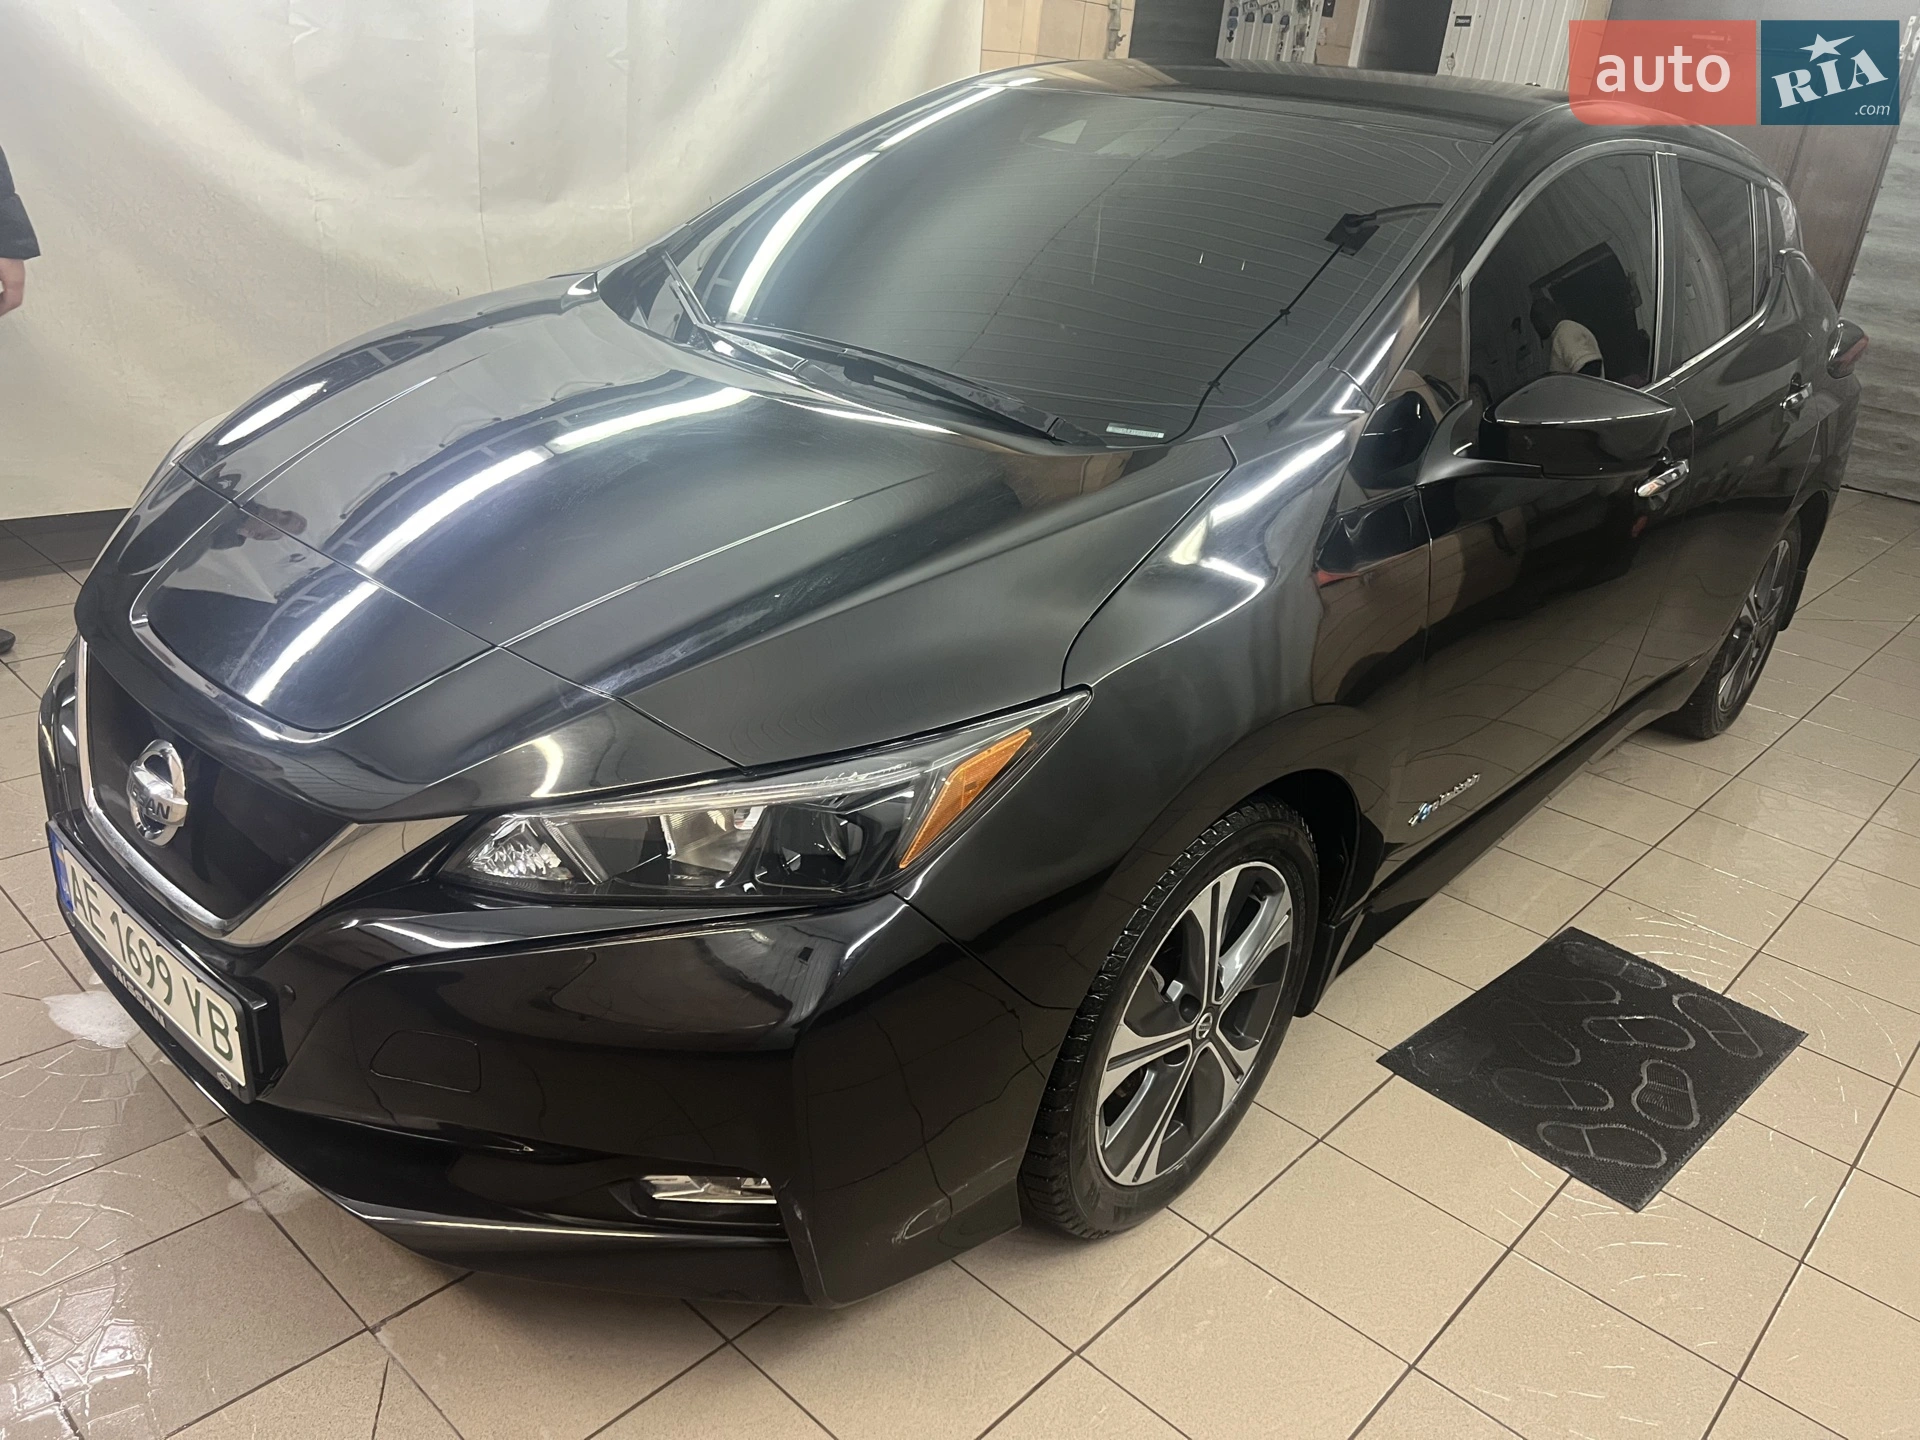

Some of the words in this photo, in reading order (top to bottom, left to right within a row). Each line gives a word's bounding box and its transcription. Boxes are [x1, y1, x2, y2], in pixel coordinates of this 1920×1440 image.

[70, 864, 107, 942] AE
[109, 910, 173, 1006] 1699
[181, 974, 234, 1062] YB
[111, 964, 166, 1029] NISSAN
